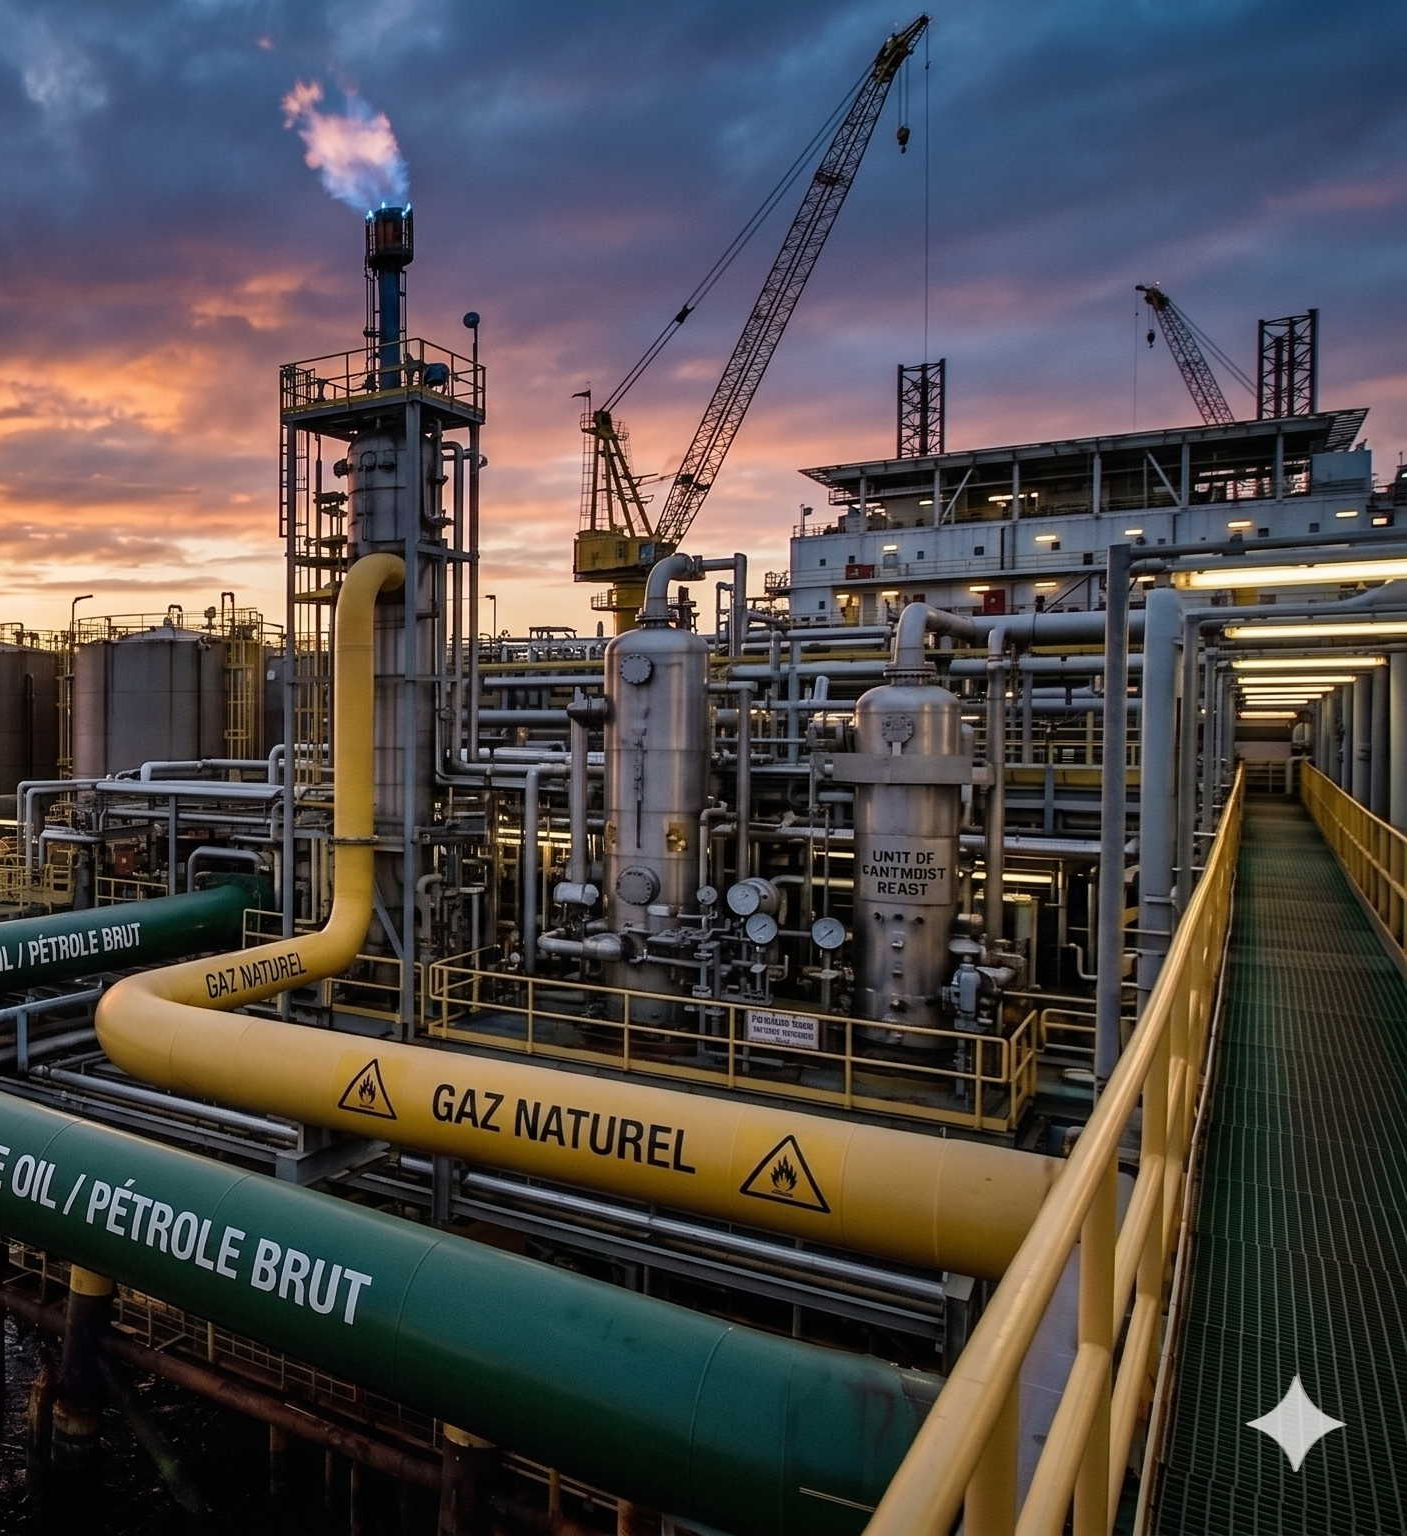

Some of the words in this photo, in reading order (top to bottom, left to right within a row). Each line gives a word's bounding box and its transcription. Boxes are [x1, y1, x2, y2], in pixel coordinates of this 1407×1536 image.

[877, 881, 928, 896] REAST
[17, 945, 25, 969] /
[29, 929, 99, 966] PÉTROLE
[102, 922, 141, 951] BRUT
[205, 968, 238, 999] GAZ
[241, 952, 307, 989] NATUREL
[431, 1083, 505, 1133] GAZ
[514, 1098, 696, 1175] NATUREL
[11, 1154, 57, 1214] OIL
[62, 1173, 87, 1215] /
[86, 1178, 246, 1280] PÉTROLE
[249, 1237, 373, 1326] BRUT
